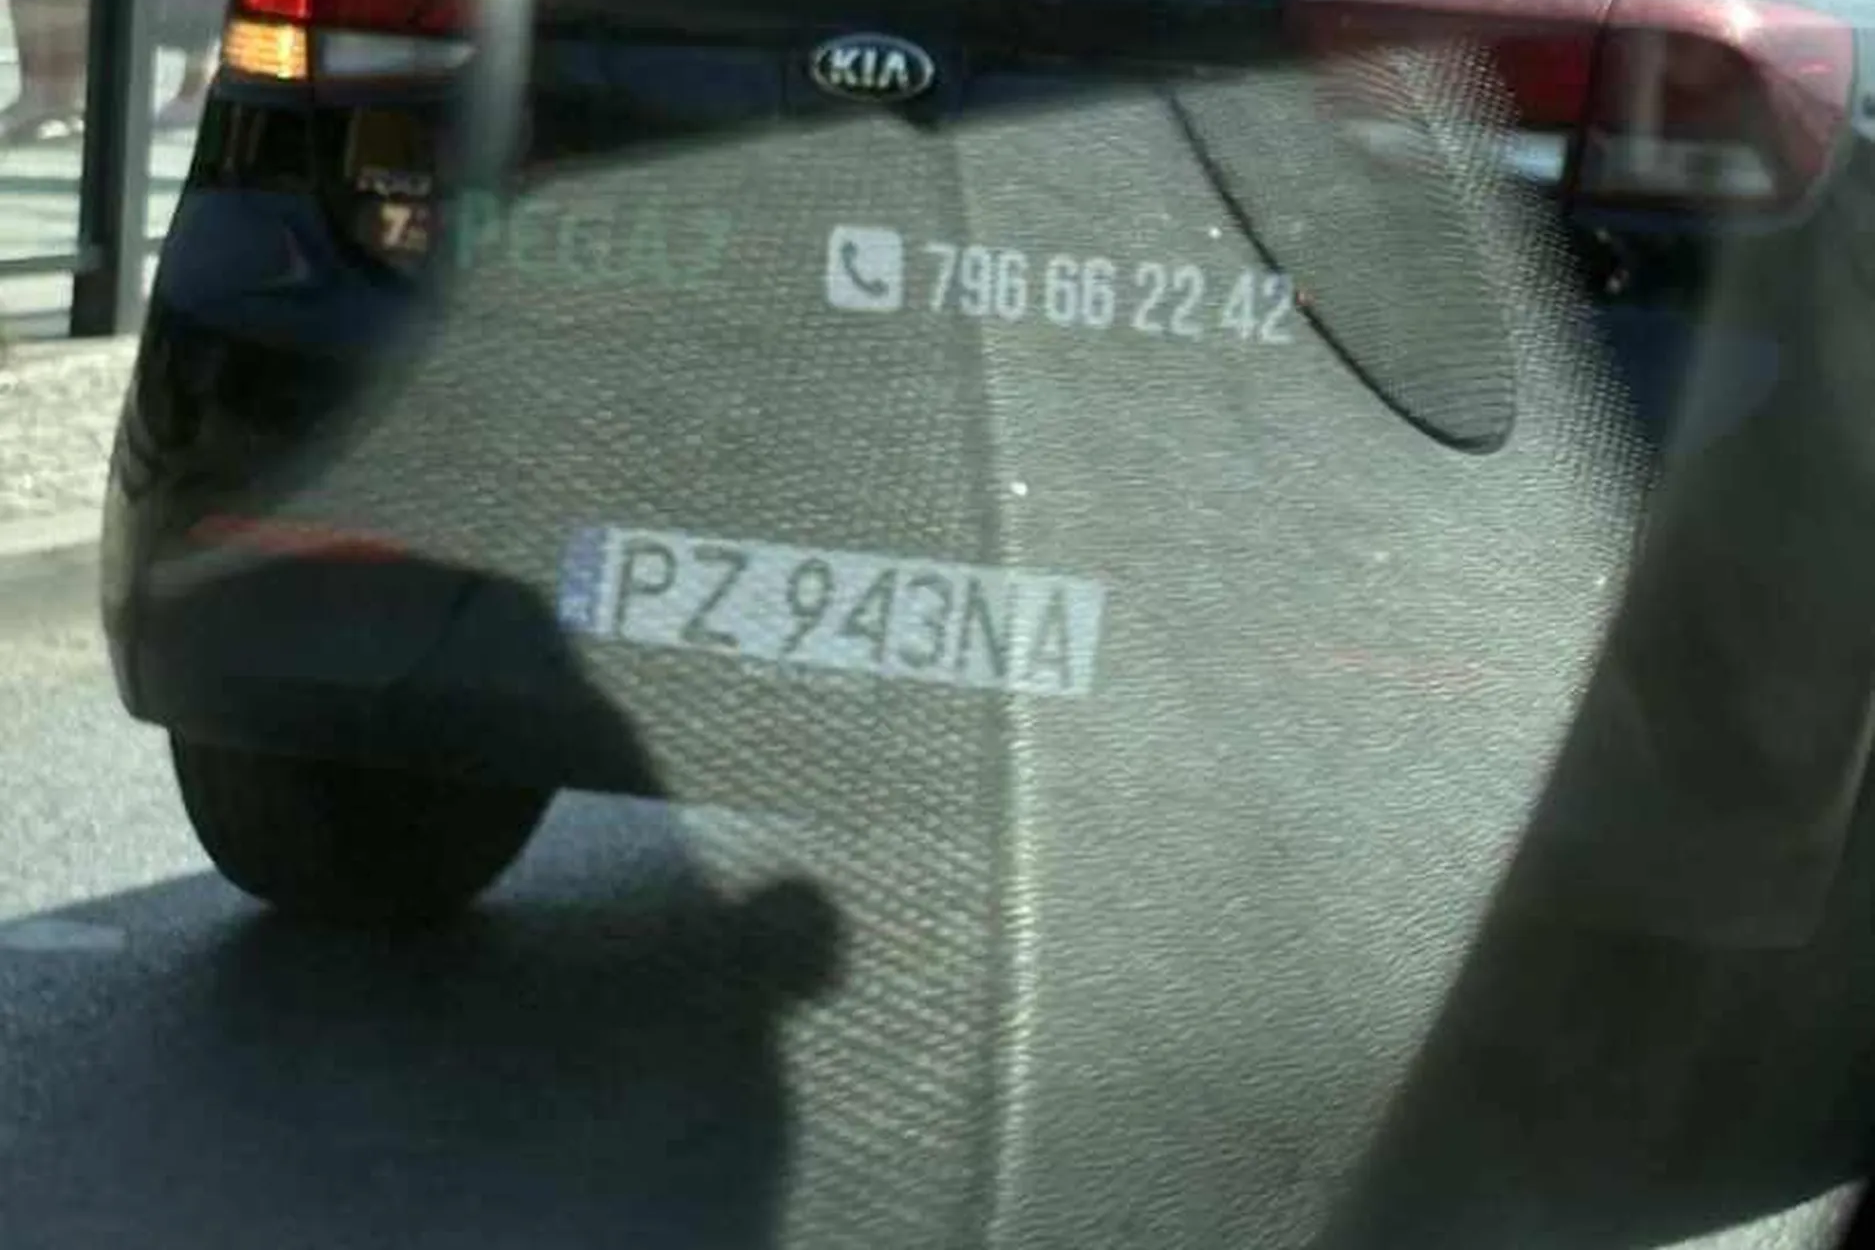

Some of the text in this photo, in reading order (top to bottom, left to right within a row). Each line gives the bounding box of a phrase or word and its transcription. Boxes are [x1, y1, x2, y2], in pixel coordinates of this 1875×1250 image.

[830, 47, 910, 88] KIA
[924, 241, 1296, 346] 796 66 22 42
[613, 536, 748, 649] PZ
